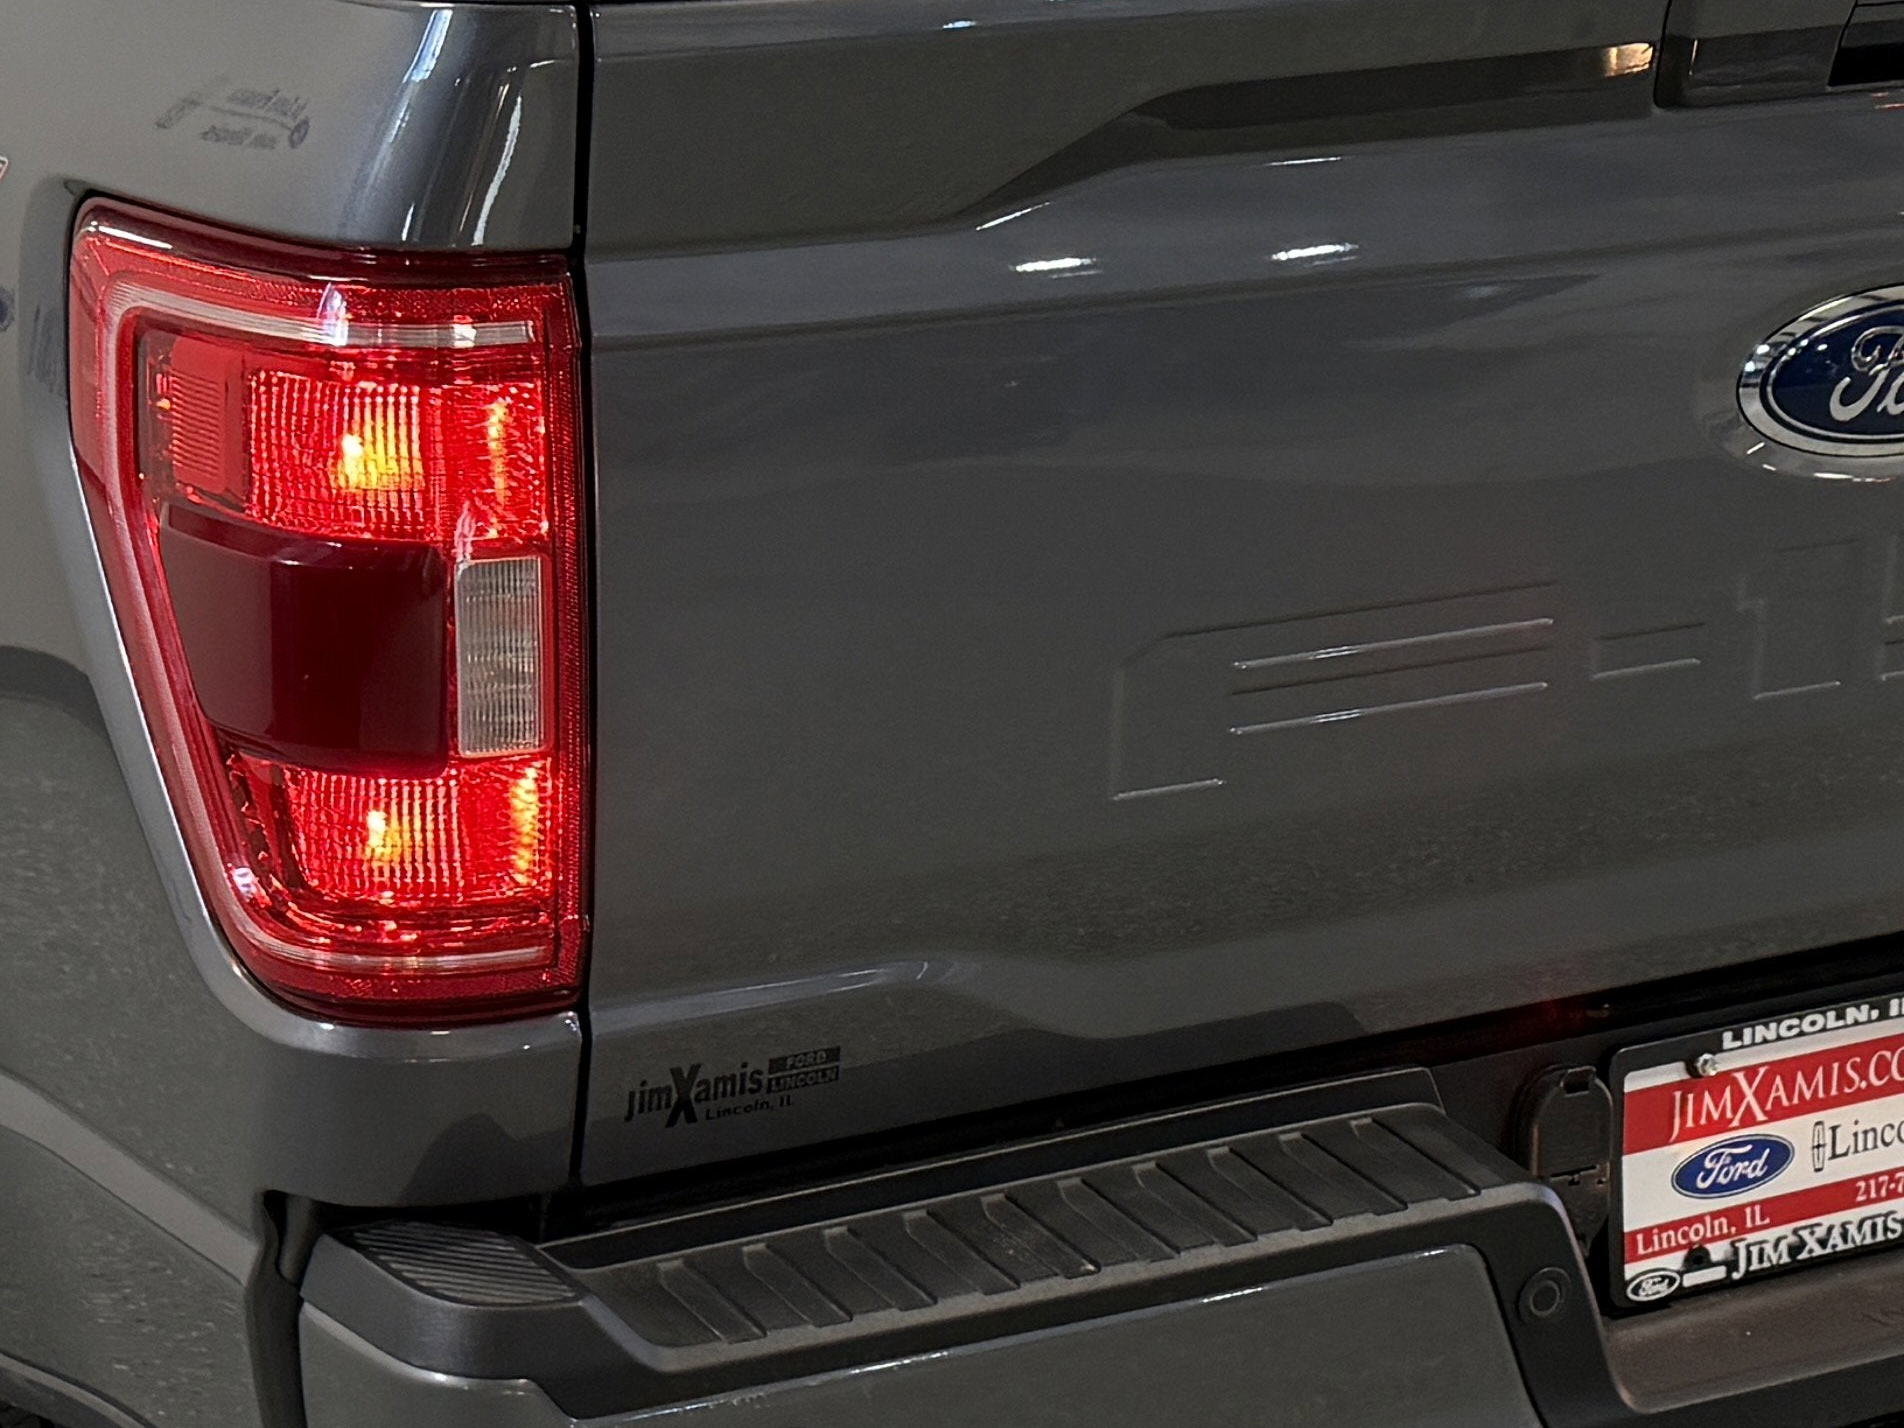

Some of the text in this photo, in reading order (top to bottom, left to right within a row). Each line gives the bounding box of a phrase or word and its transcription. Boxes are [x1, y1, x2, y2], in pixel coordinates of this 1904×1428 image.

[1722, 1003, 1880, 1050] LINCOLN,
[785, 1050, 827, 1069] FORD
[1696, 1144, 1770, 1188] Ford
[1635, 1205, 1771, 1256] Lincoln, IL
[1731, 1211, 1904, 1279] JIM XAMIS
[1637, 1274, 1671, 1298] Ford
